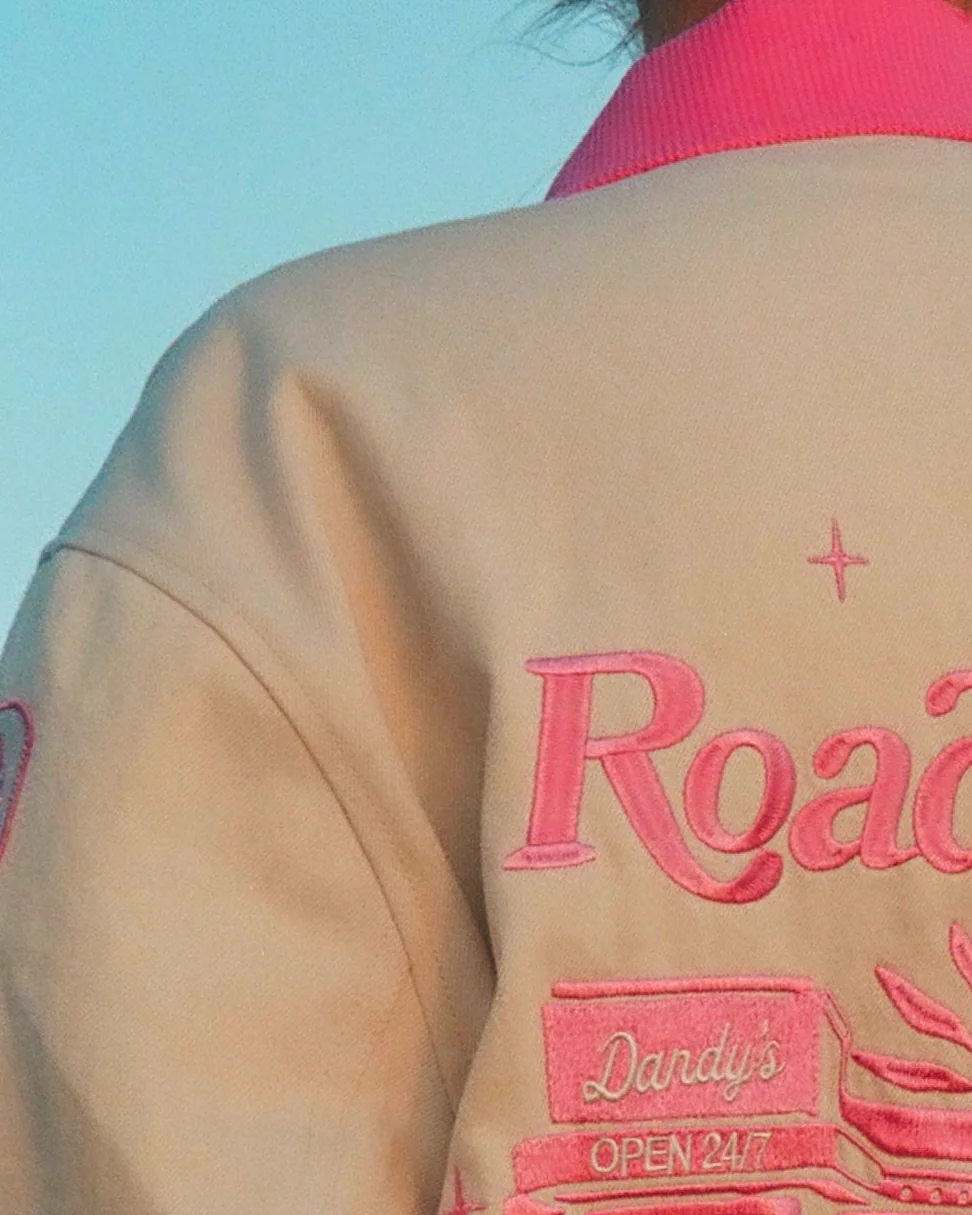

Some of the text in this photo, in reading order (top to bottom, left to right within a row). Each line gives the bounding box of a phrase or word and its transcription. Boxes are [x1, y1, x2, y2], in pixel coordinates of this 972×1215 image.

[582, 1019, 785, 1102] Dandy's
[590, 1131, 773, 1177] OPEN 24/7
